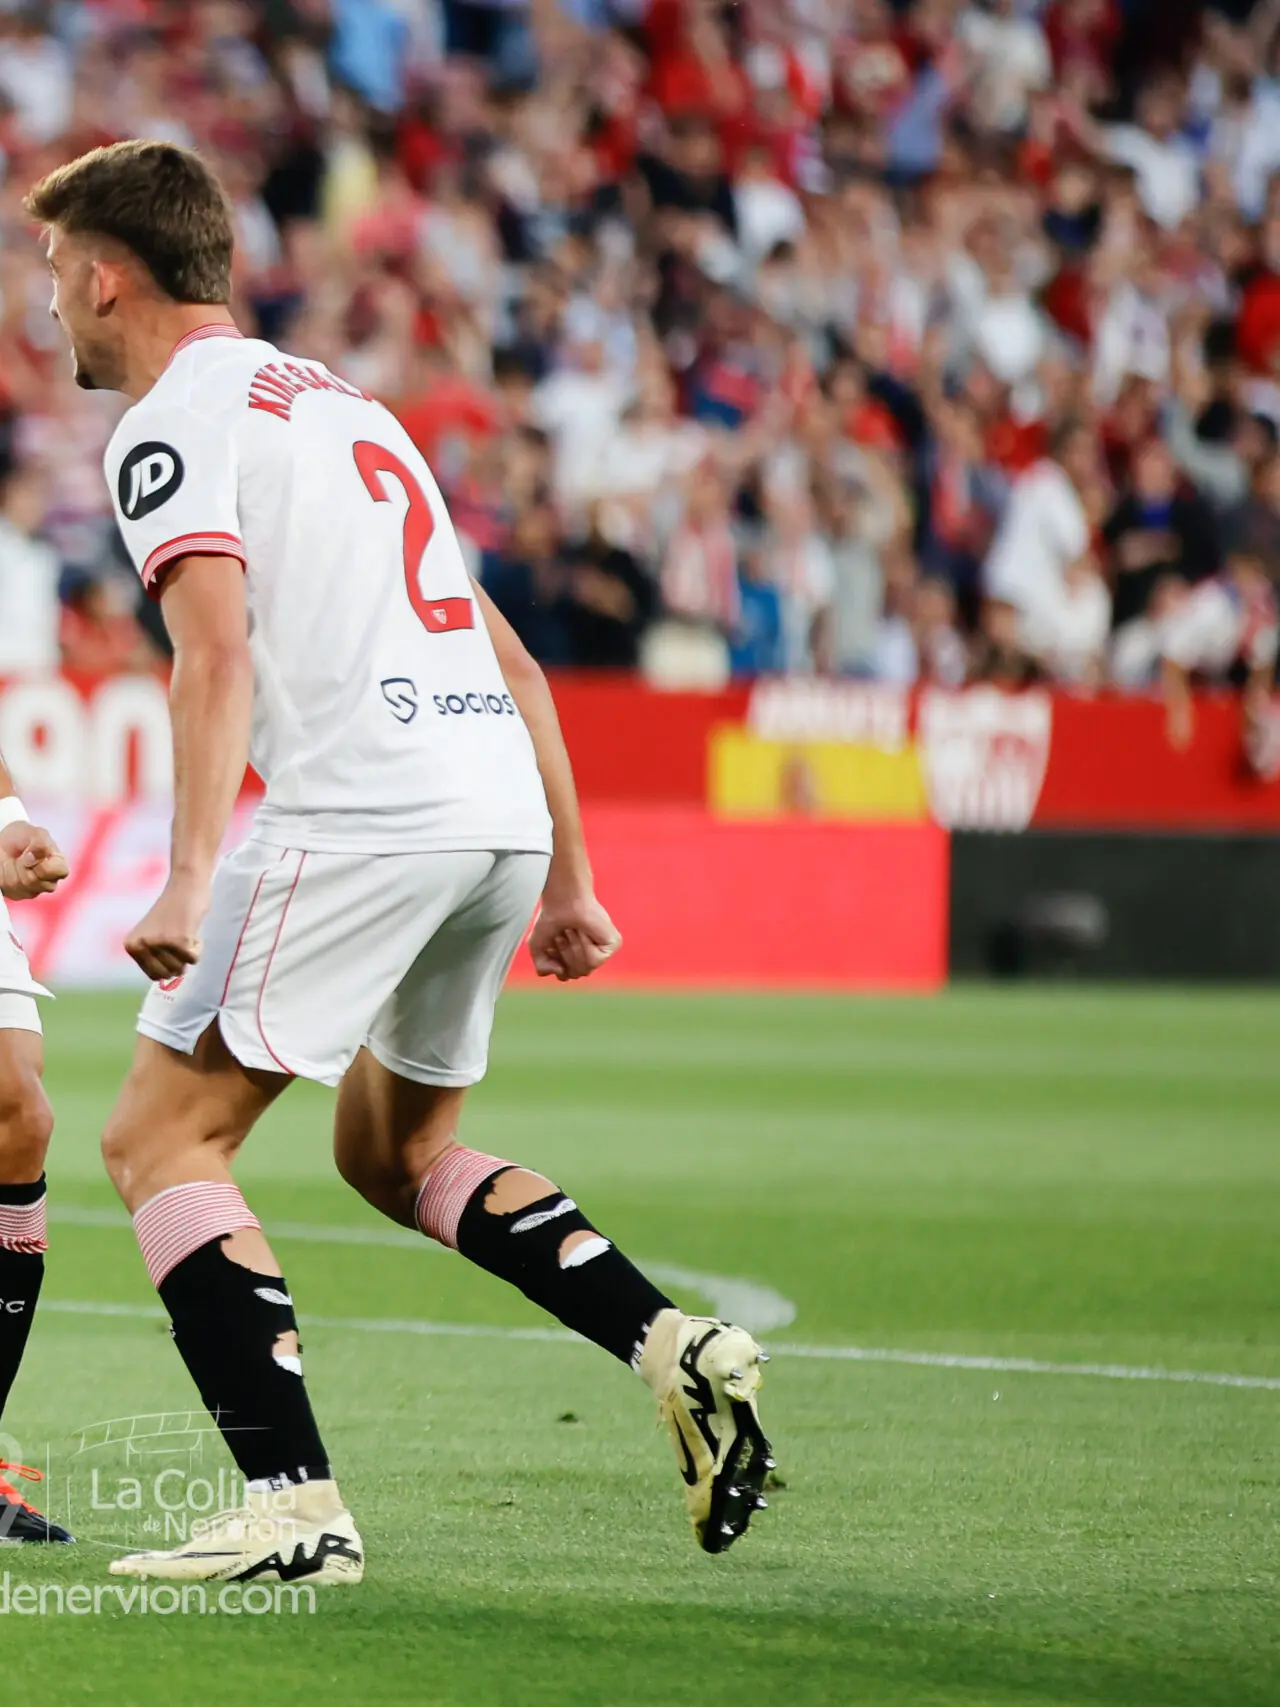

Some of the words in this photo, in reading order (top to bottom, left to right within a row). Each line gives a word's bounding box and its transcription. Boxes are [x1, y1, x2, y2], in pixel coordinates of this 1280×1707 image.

[128, 451, 175, 514] JD
[352, 440, 475, 633] 2
[433, 692, 516, 716] SOCIOS
